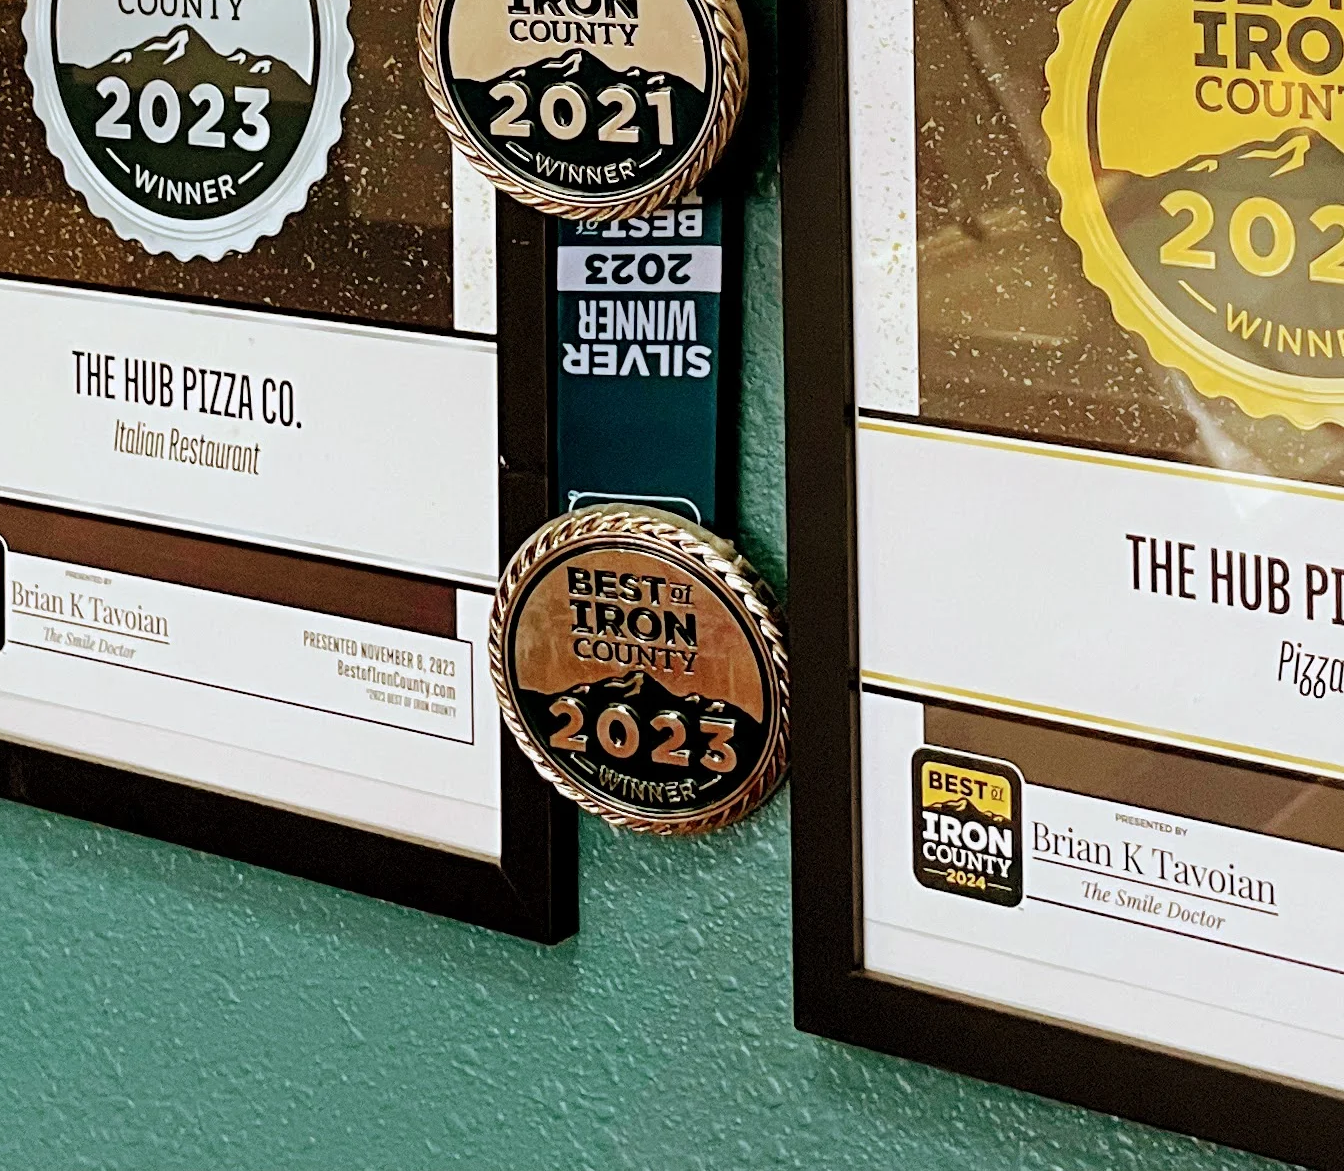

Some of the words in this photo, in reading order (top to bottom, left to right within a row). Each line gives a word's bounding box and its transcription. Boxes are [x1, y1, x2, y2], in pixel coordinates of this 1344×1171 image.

[509, 19, 639, 46] COUNTY
[96, 76, 271, 152] 2023
[489, 81, 674, 145] 2021
[135, 164, 236, 205] WINNER
[534, 152, 637, 185] WINNER
[562, 343, 712, 378] SILVER
[72, 350, 115, 399] THE
[125, 358, 173, 407] HUB
[183, 366, 253, 421] PIZZA
[262, 378, 302, 428] CO.
[114, 419, 164, 459] Italian
[168, 428, 261, 475] Restaurant
[567, 567, 666, 606] BEST
[1126, 534, 1196, 600] THE
[1211, 547, 1290, 615] HUB
[12, 581, 64, 616] Brian
[70, 592, 83, 619] K
[88, 597, 169, 637] Tavoian
[570, 600, 697, 650] IRON
[573, 639, 697, 676] COUNTY
[1277, 640, 1344, 699] Pizza
[548, 696, 737, 773] 2023
[946, 870, 987, 891] 2024
[1032, 821, 1111, 869] Brian
[1125, 842, 1145, 875] K
[1152, 848, 1276, 906] Tavoian
[1082, 881, 1111, 904] The
[1115, 889, 1162, 916] Smile
[1167, 901, 1226, 931] Doctor
